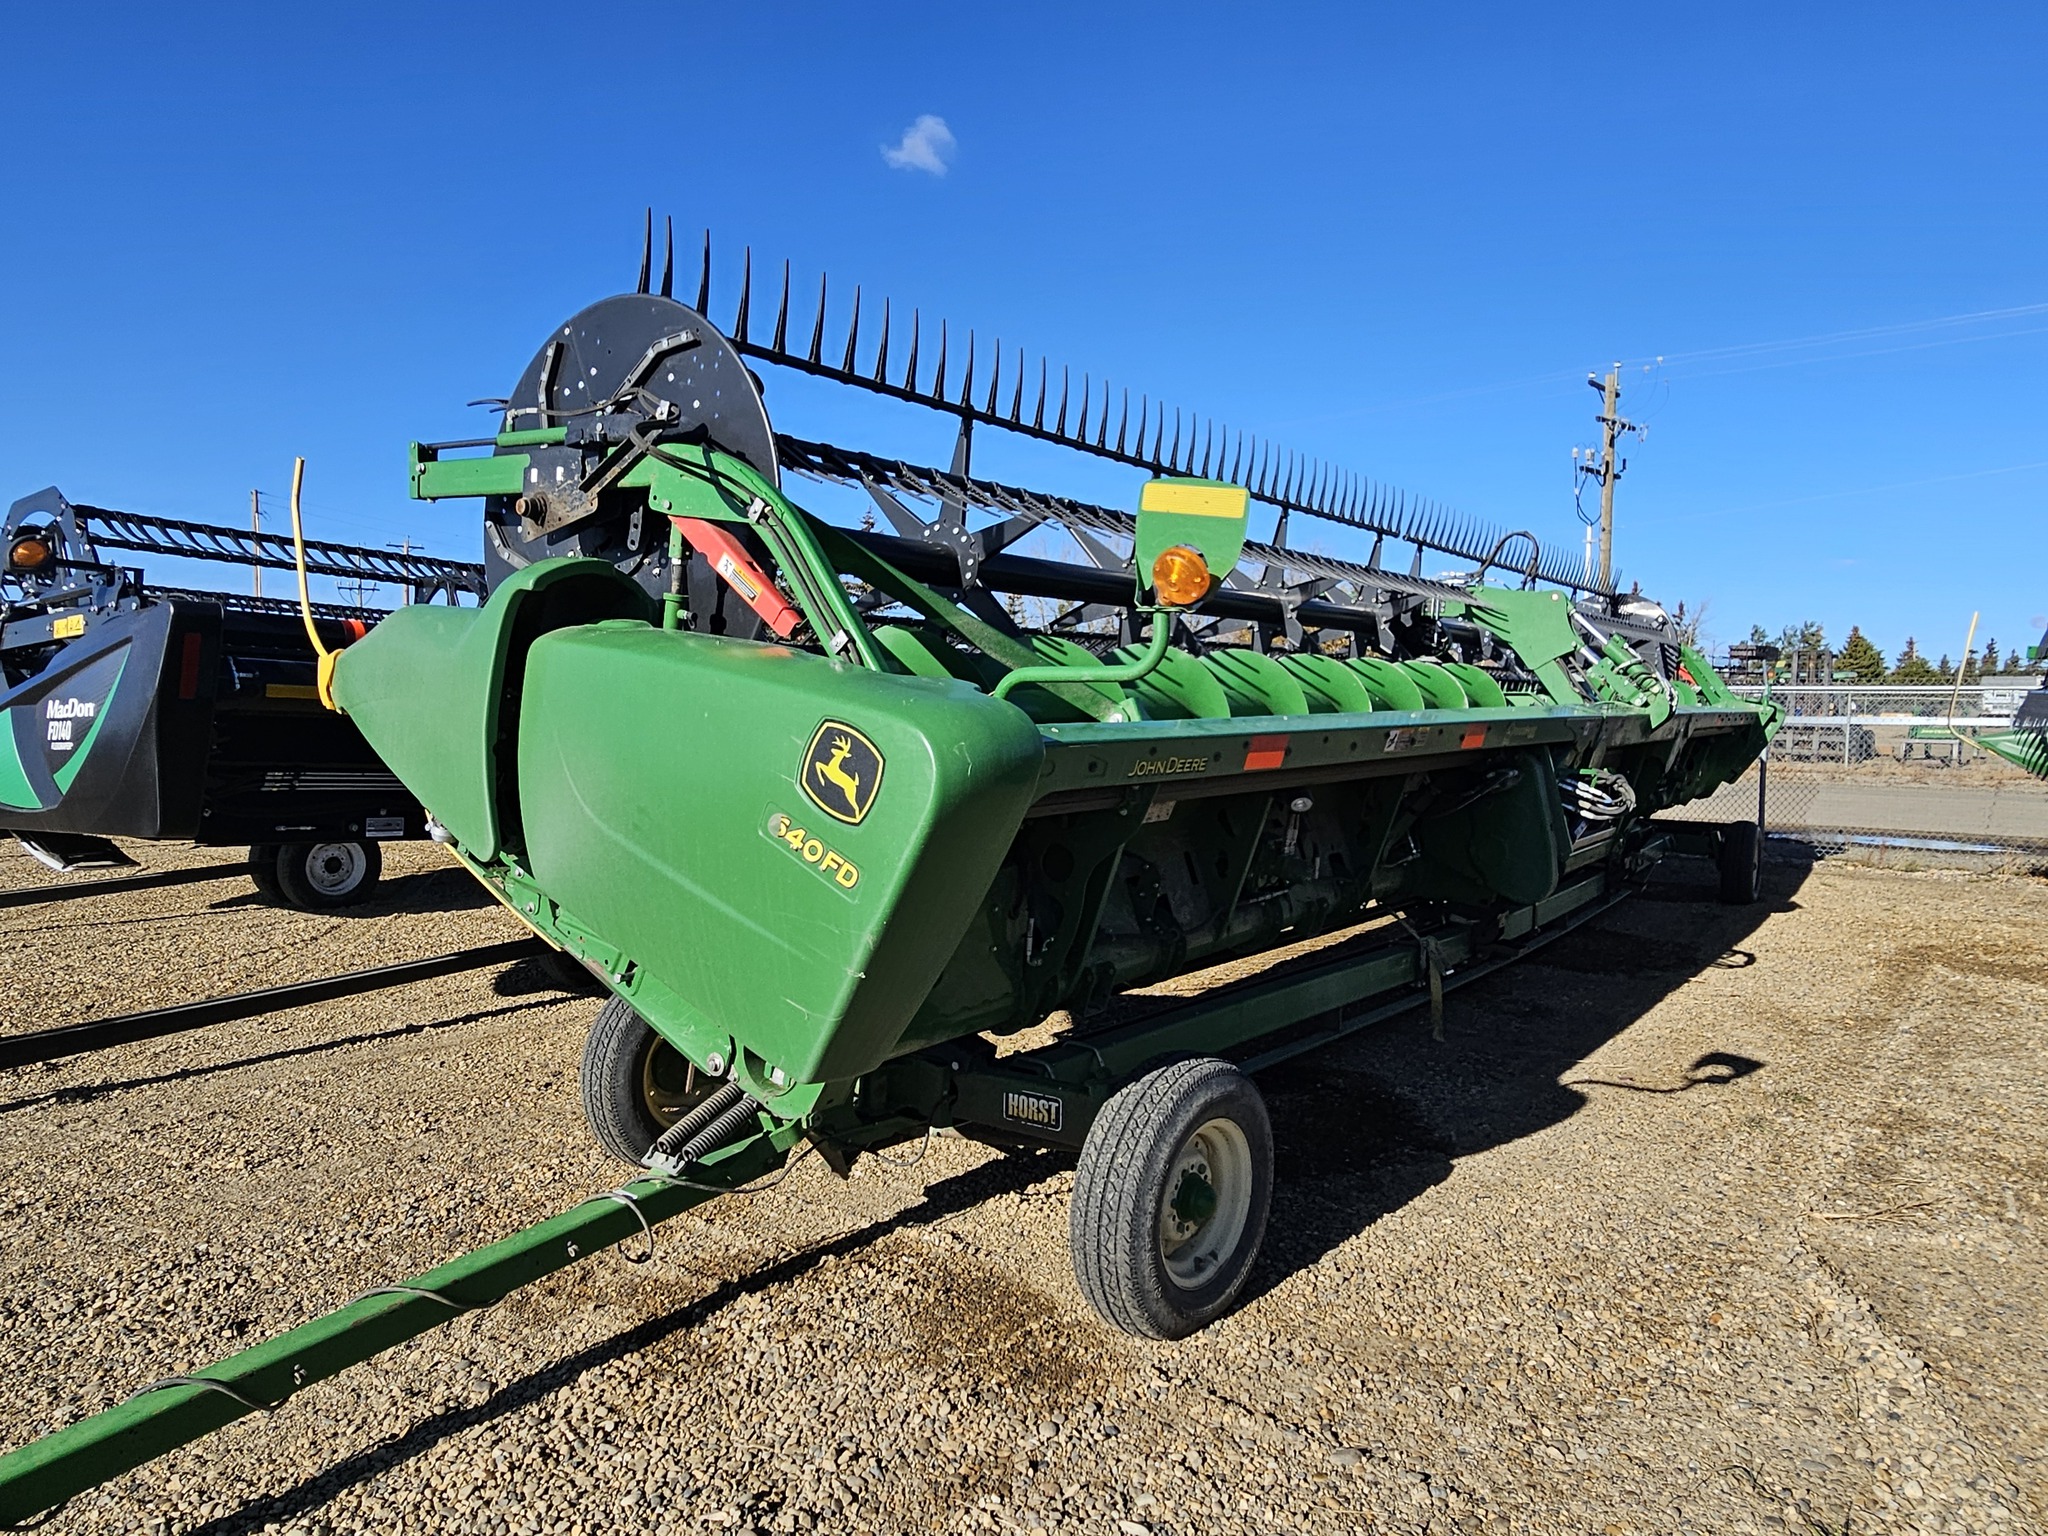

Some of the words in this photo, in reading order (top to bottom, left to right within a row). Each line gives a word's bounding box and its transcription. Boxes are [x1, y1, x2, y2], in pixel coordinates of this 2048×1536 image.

[46, 698, 95, 719] MacDon
[47, 720, 72, 741] FD140
[1008, 1092, 1059, 1125] HORST
